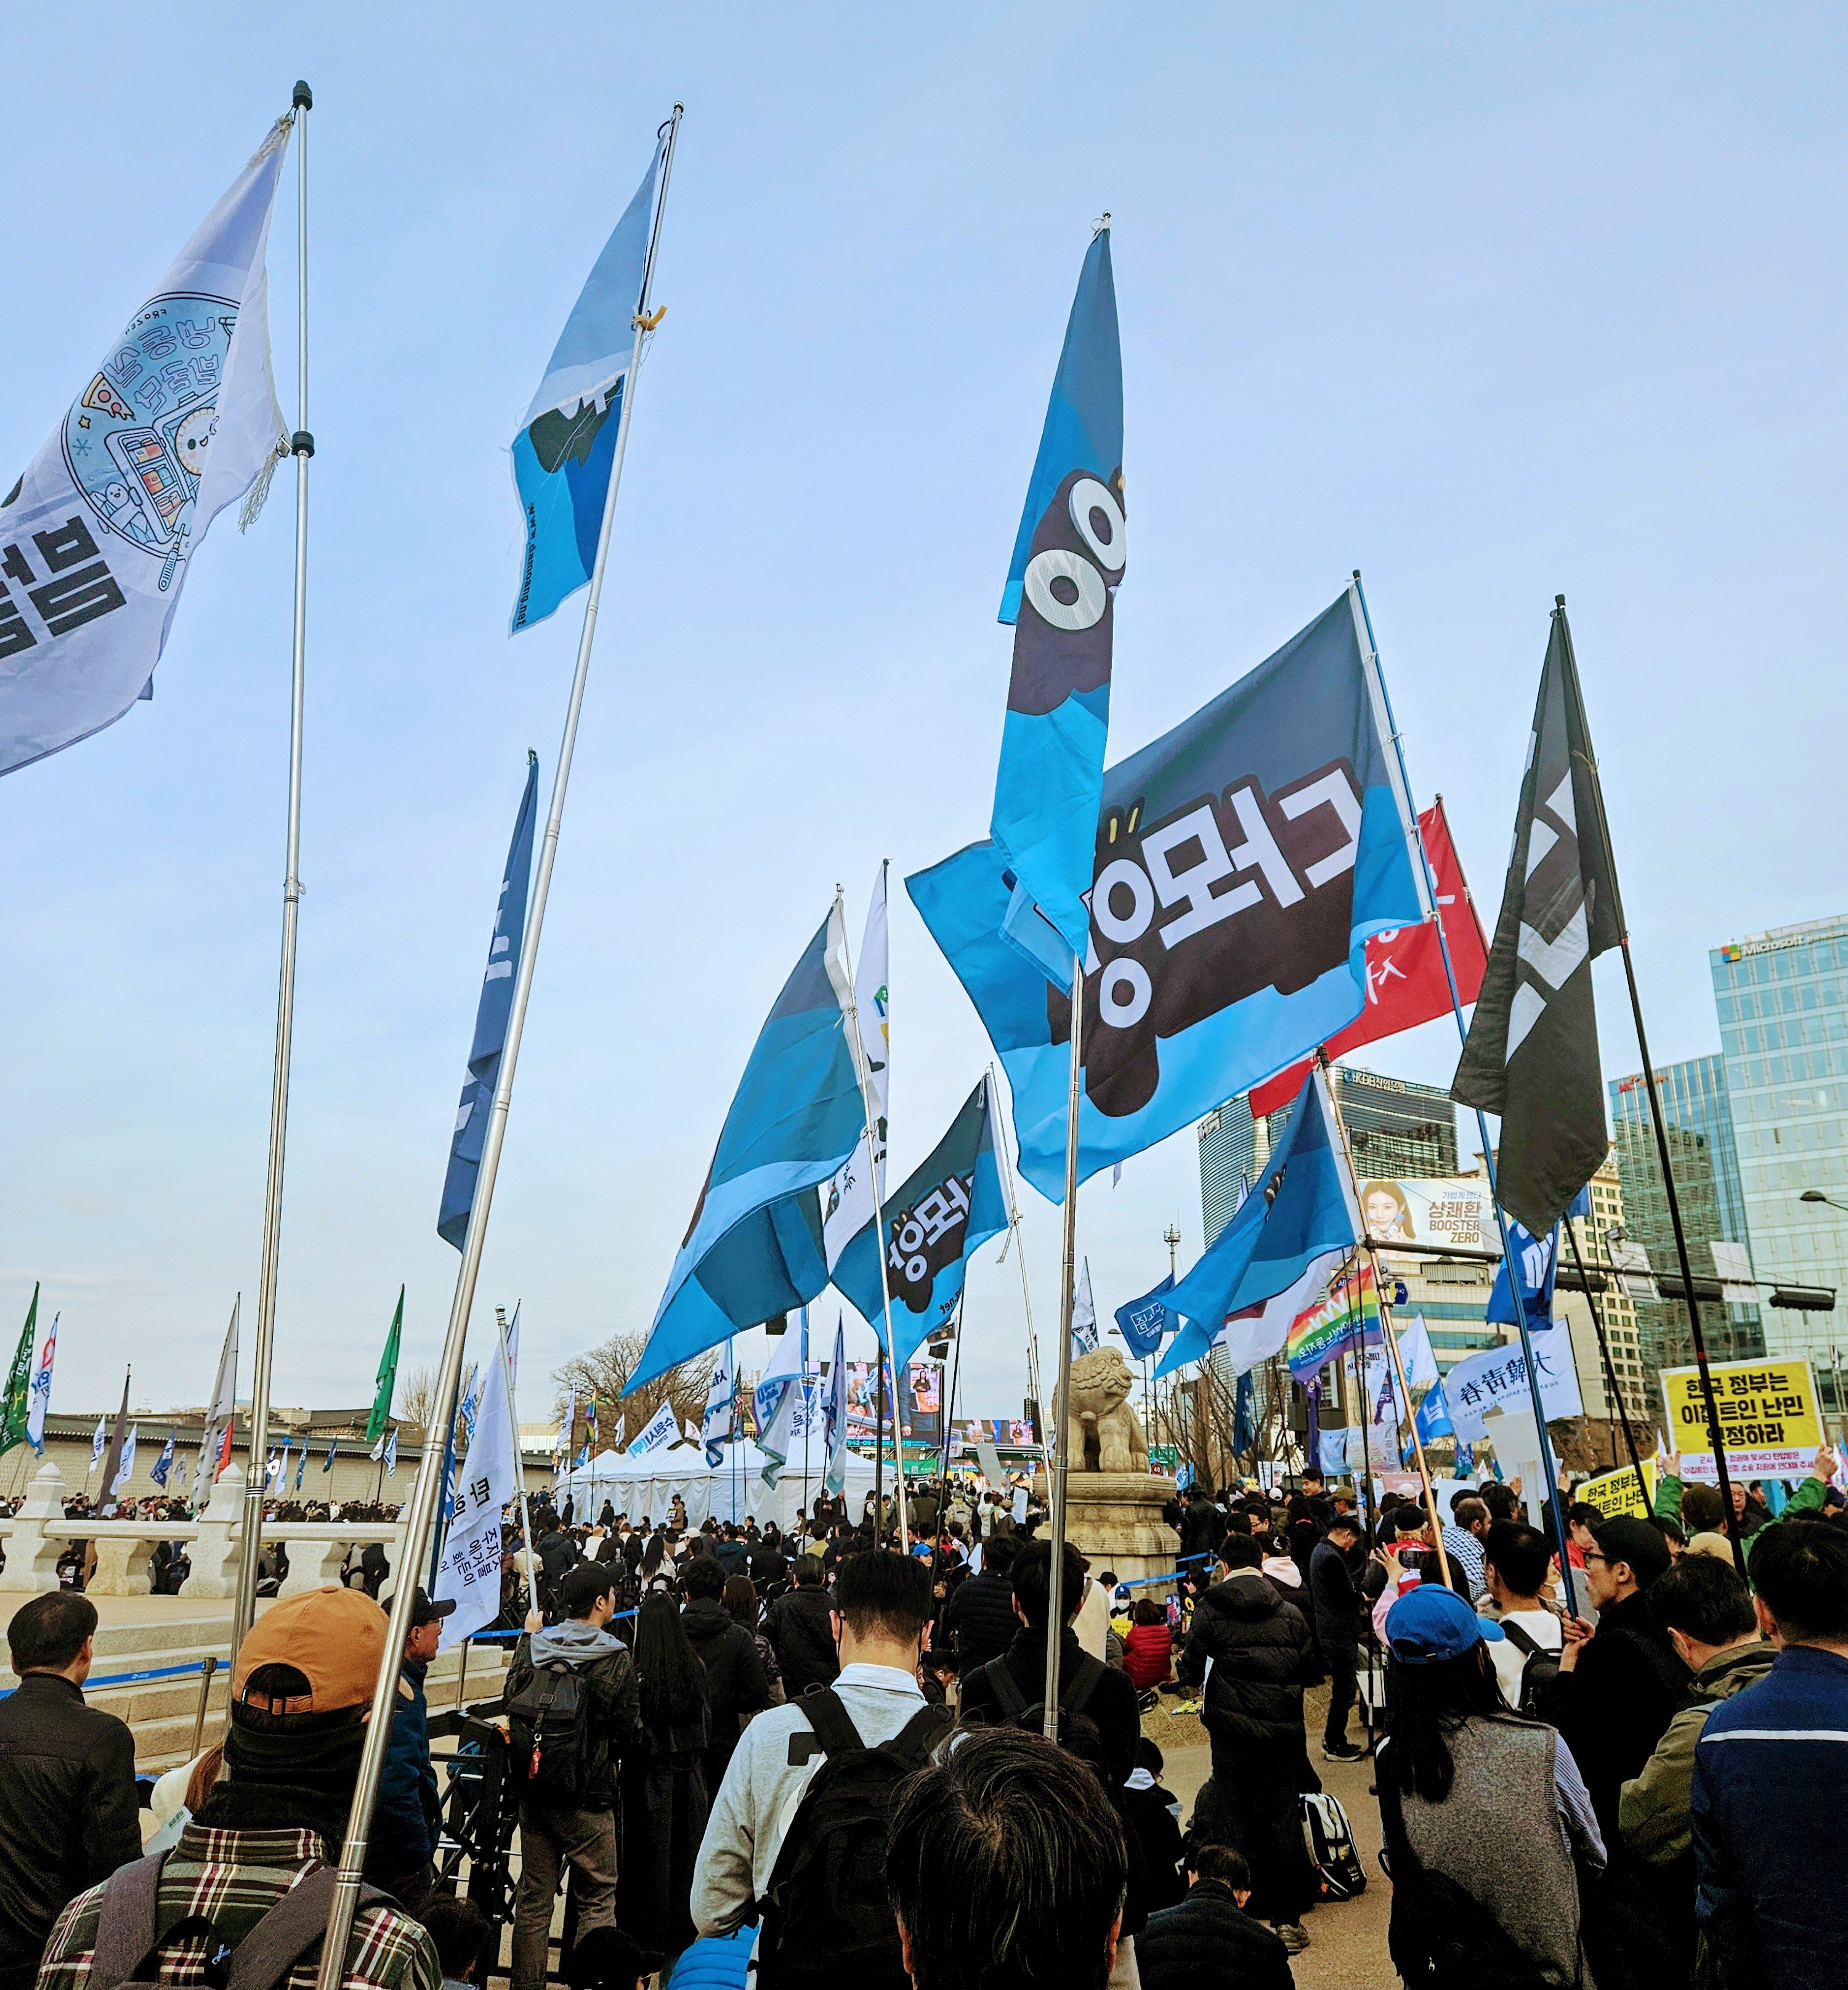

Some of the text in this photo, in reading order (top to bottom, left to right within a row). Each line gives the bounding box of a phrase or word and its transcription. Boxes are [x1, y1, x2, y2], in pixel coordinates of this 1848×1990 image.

[1741, 933, 1803, 956] Microsoft
[1429, 1201, 1482, 1219] 상쾌환
[1429, 1220, 1480, 1231] BOOSTER
[1450, 1232, 1480, 1243] ZERO
[1728, 1372, 1789, 1395] 정부는
[1762, 1395, 1804, 1418] 난민
[1587, 1473, 1639, 1503] 한국 정부는
